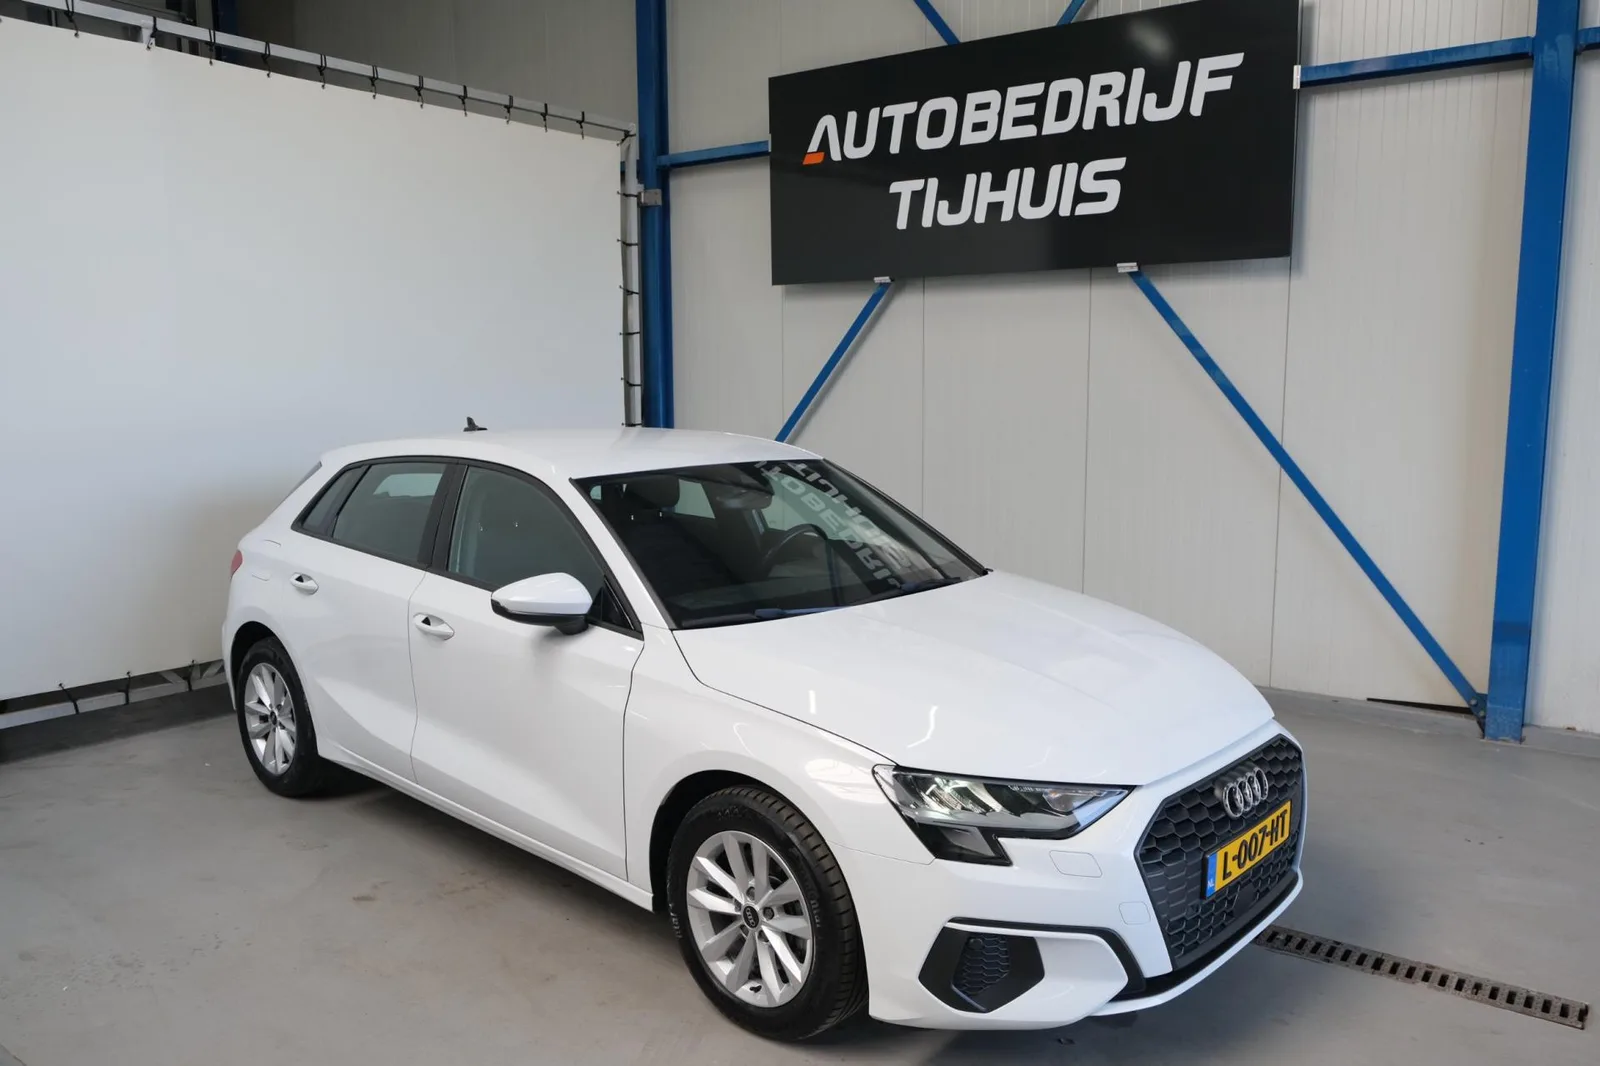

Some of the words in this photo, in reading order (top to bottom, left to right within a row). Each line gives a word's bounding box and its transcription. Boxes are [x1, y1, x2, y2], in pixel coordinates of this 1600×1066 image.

[802, 52, 1244, 165] AUTOBEDRIJF
[889, 157, 1127, 230] TIJHUIS
[1223, 810, 1287, 880] L-007-HT
